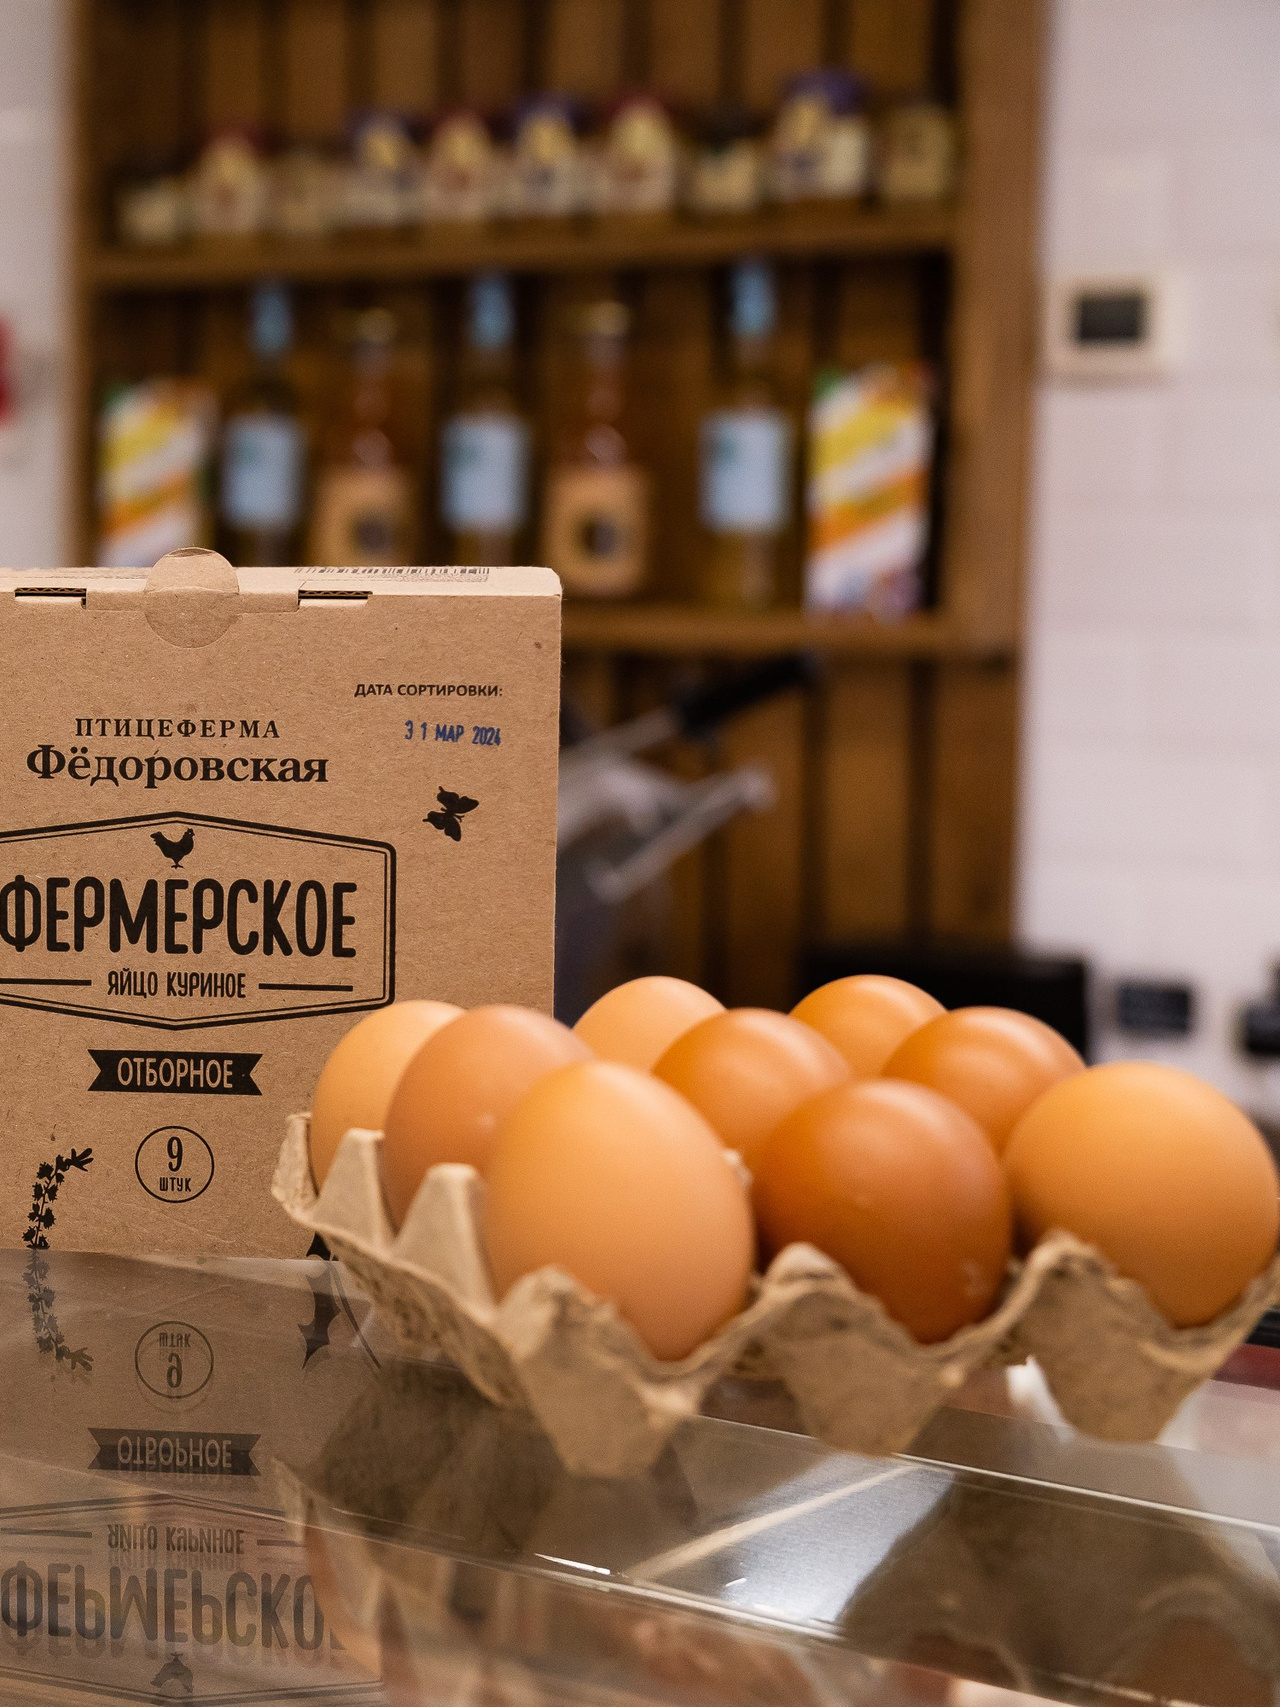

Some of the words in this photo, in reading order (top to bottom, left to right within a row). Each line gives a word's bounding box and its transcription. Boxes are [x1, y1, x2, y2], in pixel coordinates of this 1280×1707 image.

[354, 684, 393, 697] ДАТА
[397, 684, 503, 697] СОРТИРОВКИ:
[74, 717, 280, 740] ПТИЦЕФЕРМА
[434, 723, 465, 743] МАР
[471, 725, 502, 746] 2024
[26, 744, 330, 789] Фёдоровская
[0, 874, 358, 959] ФЕРМЕРСКОЕ
[107, 967, 159, 998] ЯЙЦО
[166, 971, 247, 999] КУРИНОЕ
[117, 1057, 233, 1089] ОТБОРНОЕ
[166, 1136, 184, 1173] 9
[159, 1176, 192, 1193] ШТУК
